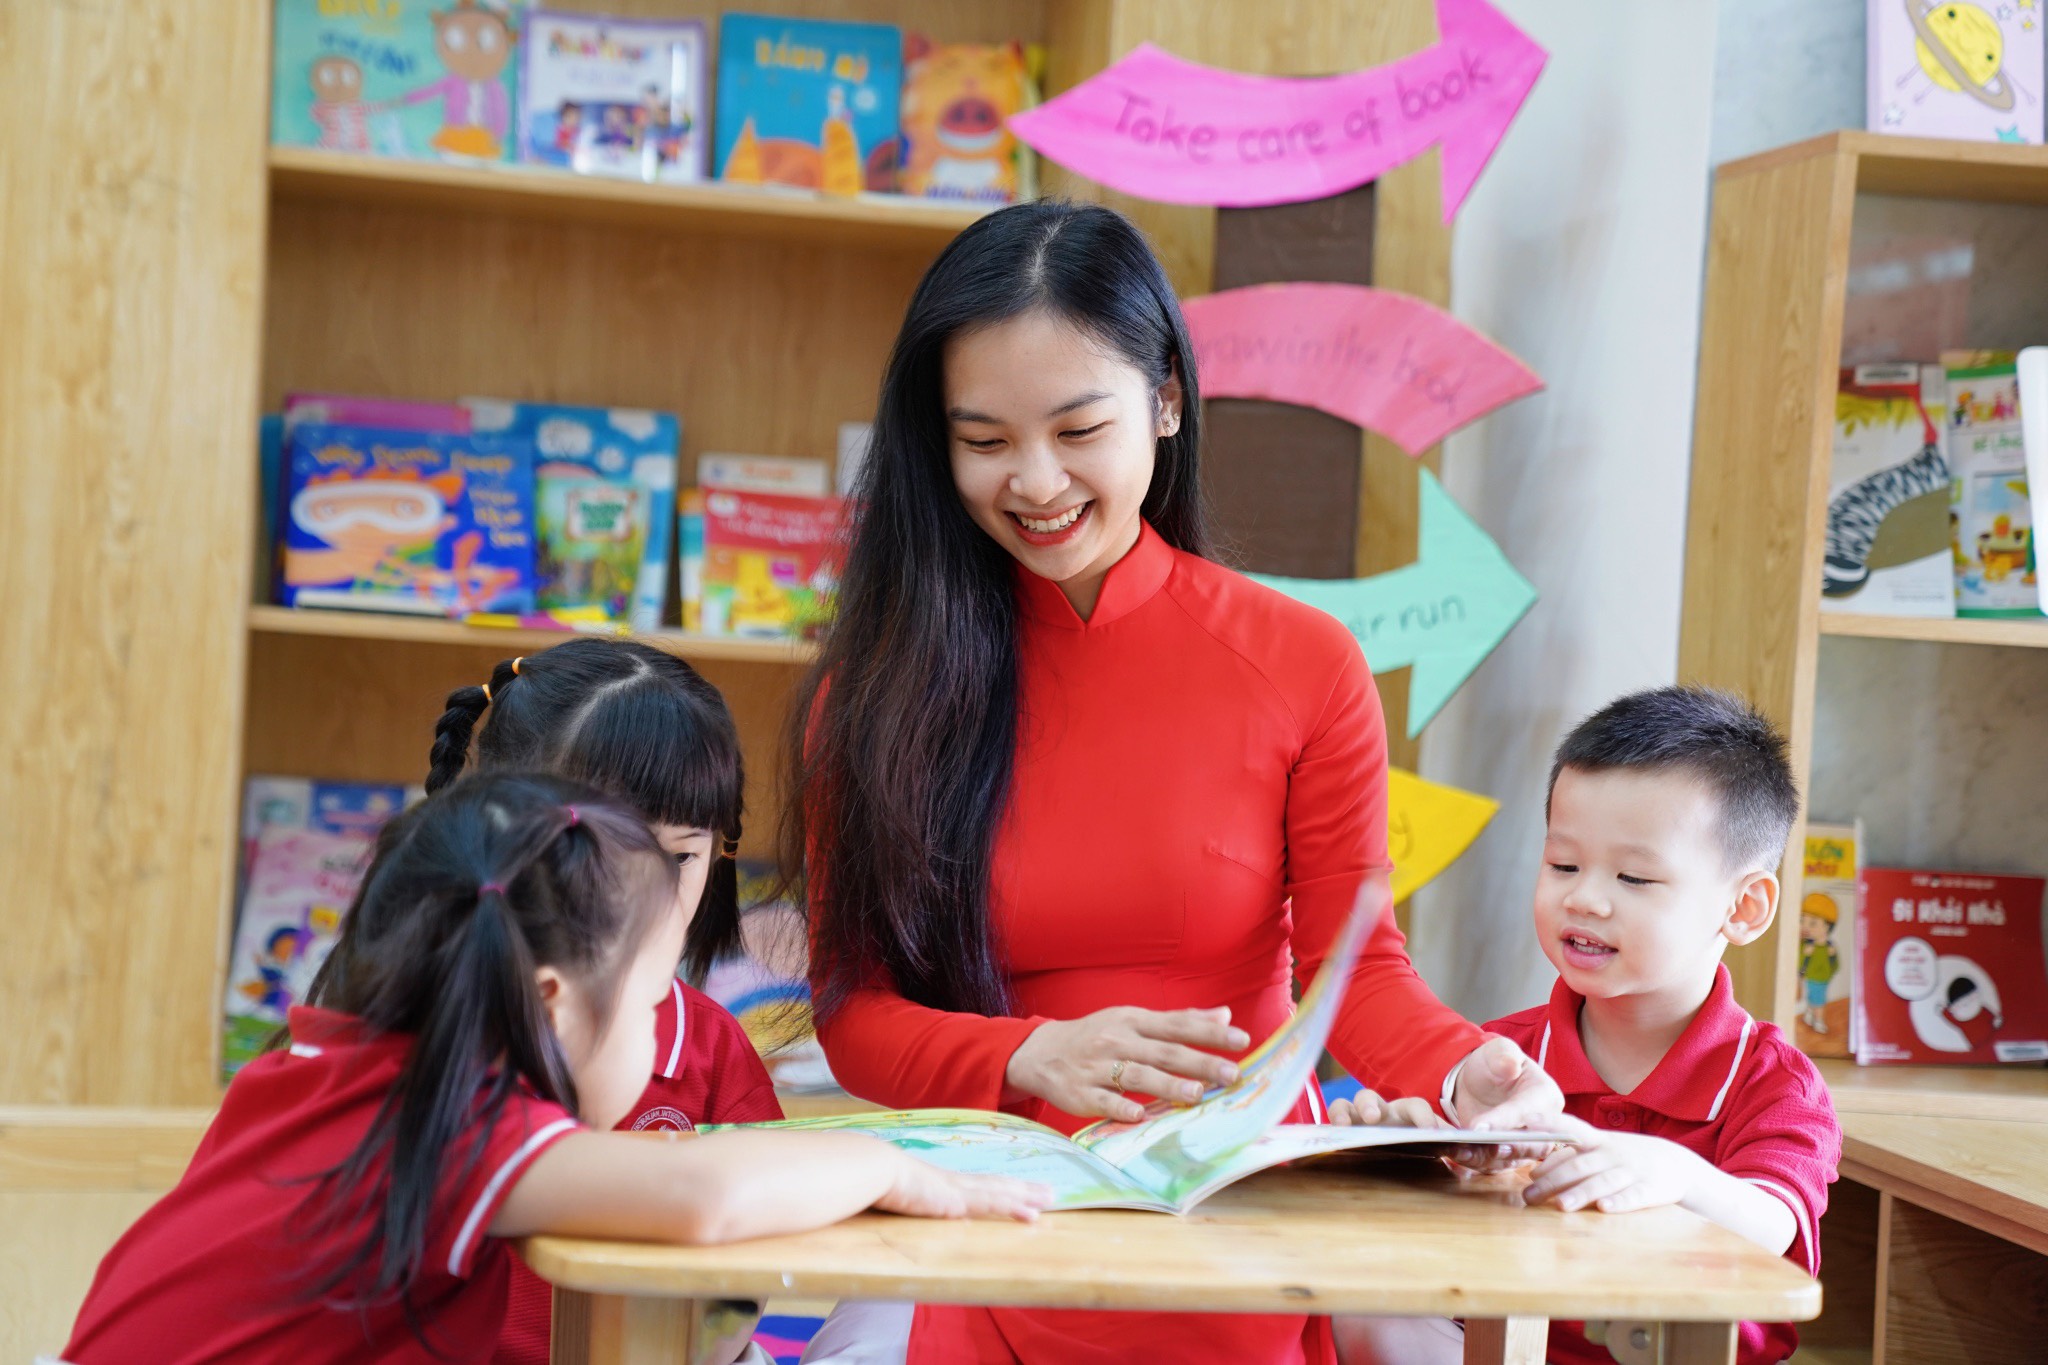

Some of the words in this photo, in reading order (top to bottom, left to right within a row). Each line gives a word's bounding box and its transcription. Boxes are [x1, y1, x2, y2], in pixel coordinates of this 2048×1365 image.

[1113, 89, 1220, 164] Take
[1236, 118, 1329, 164] care
[1343, 97, 1384, 147] of
[1395, 47, 1492, 123] book
[1399, 594, 1467, 633] run
